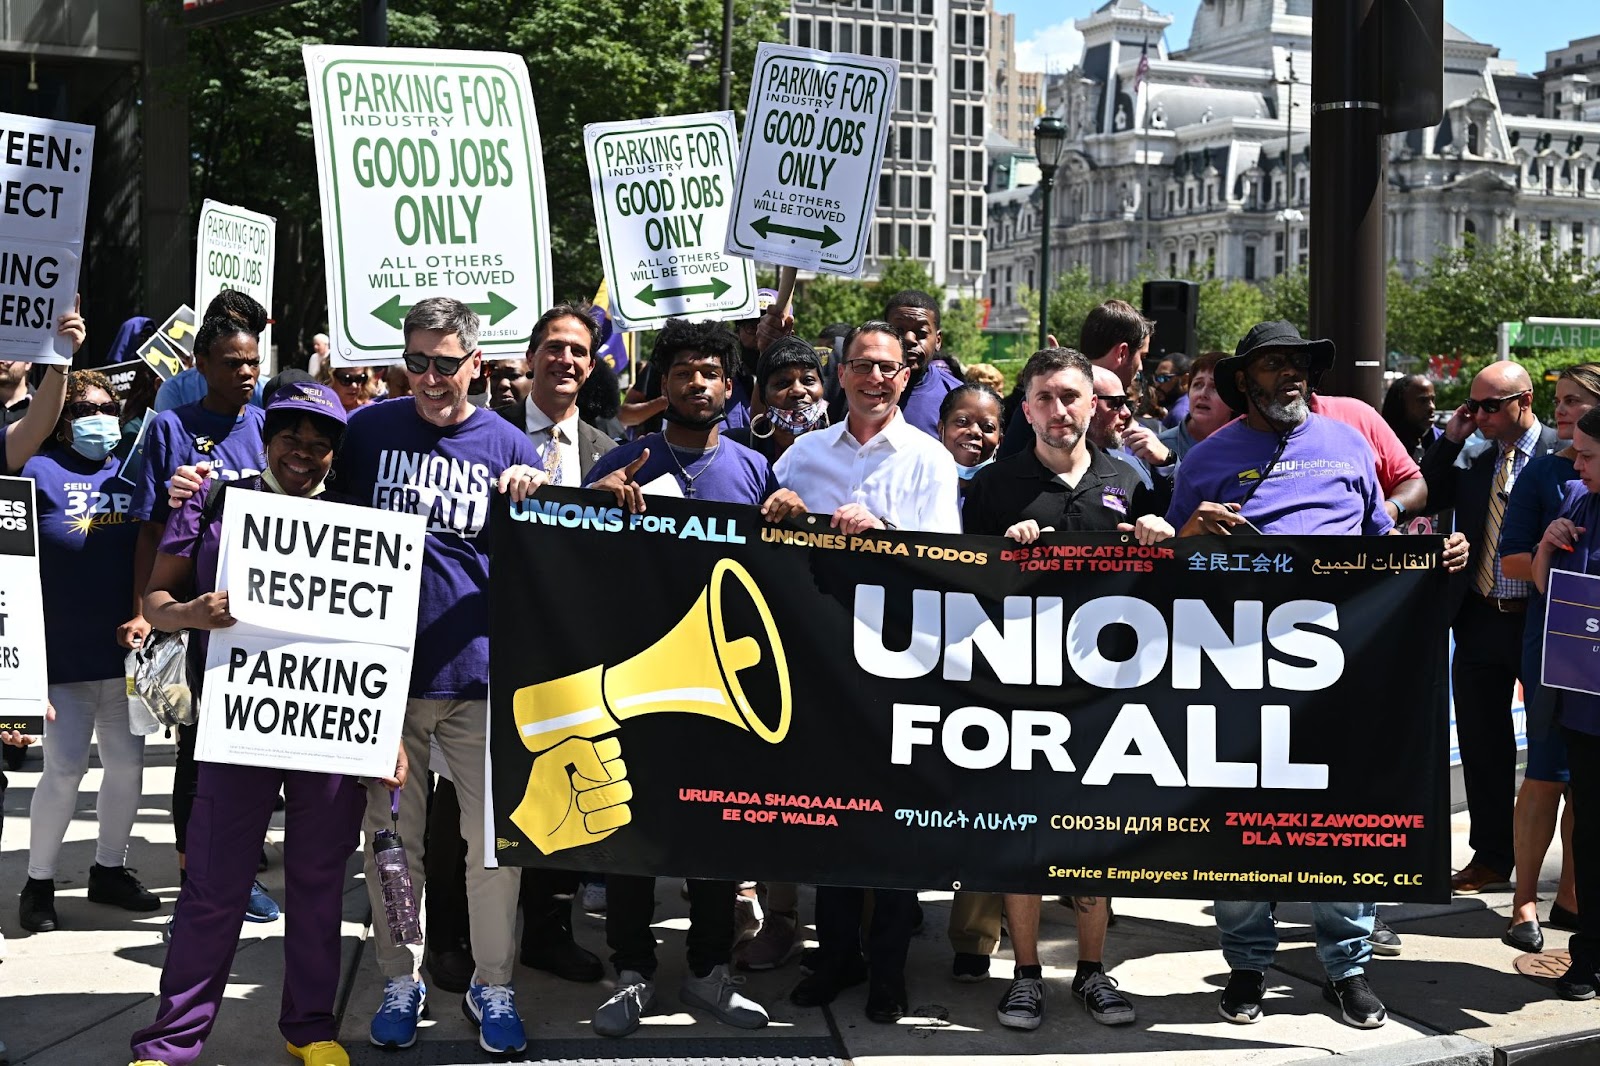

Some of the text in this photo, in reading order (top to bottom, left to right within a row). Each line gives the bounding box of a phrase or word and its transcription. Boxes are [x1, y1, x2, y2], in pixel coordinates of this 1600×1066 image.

[337, 72, 512, 127] PARKING FOR
[766, 93, 834, 109] INDUSTRY
[768, 64, 878, 115] PARKING FOR
[342, 114, 454, 127] INDUSTRY
[763, 109, 866, 156] GOOD JOBS
[0, 129, 82, 173] EEN:
[352, 137, 513, 188] GOOD JOBS
[603, 131, 723, 169] PARKING FOR
[608, 162, 683, 177] INDUSTRY
[778, 151, 836, 191] ONLY
[0, 180, 63, 219] ECT
[615, 175, 724, 216] GOOD JOBS
[762, 189, 841, 209] ALL OTHERS
[395, 194, 482, 246] ONLY
[753, 199, 846, 224] WILL BE TOWED
[206, 215, 266, 256] PARKING FOR
[206, 238, 246, 251] INDUSTRY
[645, 214, 704, 251] ONLY
[208, 250, 262, 286] GOOD JOBS
[380, 254, 503, 269] ALL OTHERS
[630, 262, 729, 281] WILL BE TOWED
[637, 252, 721, 268] ALL OTHERS
[368, 269, 515, 288] WILL BE TOWED
[303, 387, 323, 397] SEIU
[377, 449, 489, 497] UNIONS
[63, 482, 92, 491] SEIU
[1104, 485, 1126, 495] SEIU
[376, 486, 479, 534] FOR ALL
[509, 496, 747, 544] UNIONS FOR ALL
[242, 513, 413, 571] NUVEEN:
[761, 527, 988, 565] UNIONES PARA TODOS
[1000, 545, 1174, 562] DES SYNDICATS POUR
[1019, 559, 1154, 573] TOUS ET TOUTES
[1188, 551, 1293, 573] 全民工会化
[1311, 552, 1436, 574] النقابات للجميع
[247, 567, 393, 620] RESPECT
[853, 583, 1345, 691] UNIONS
[228, 647, 388, 699] PARKING
[224, 693, 381, 745] WORKERS!
[890, 702, 1329, 790] FOR ALL
[678, 788, 884, 812] URURADA SHAQAALAHA
[722, 808, 838, 827] EE QOF WALBA
[894, 808, 1038, 831] ማህበራት ለሁሉም
[1050, 814, 1211, 834] СОЮЗЫ ДЛЯ ВСЕХ
[1225, 812, 1425, 831] ZWIĄZKI ZAWODOWE
[1242, 831, 1407, 847] DLA WSZYSTKICH
[1048, 866, 1423, 887] Service Employees International Union, SOC, CLC
